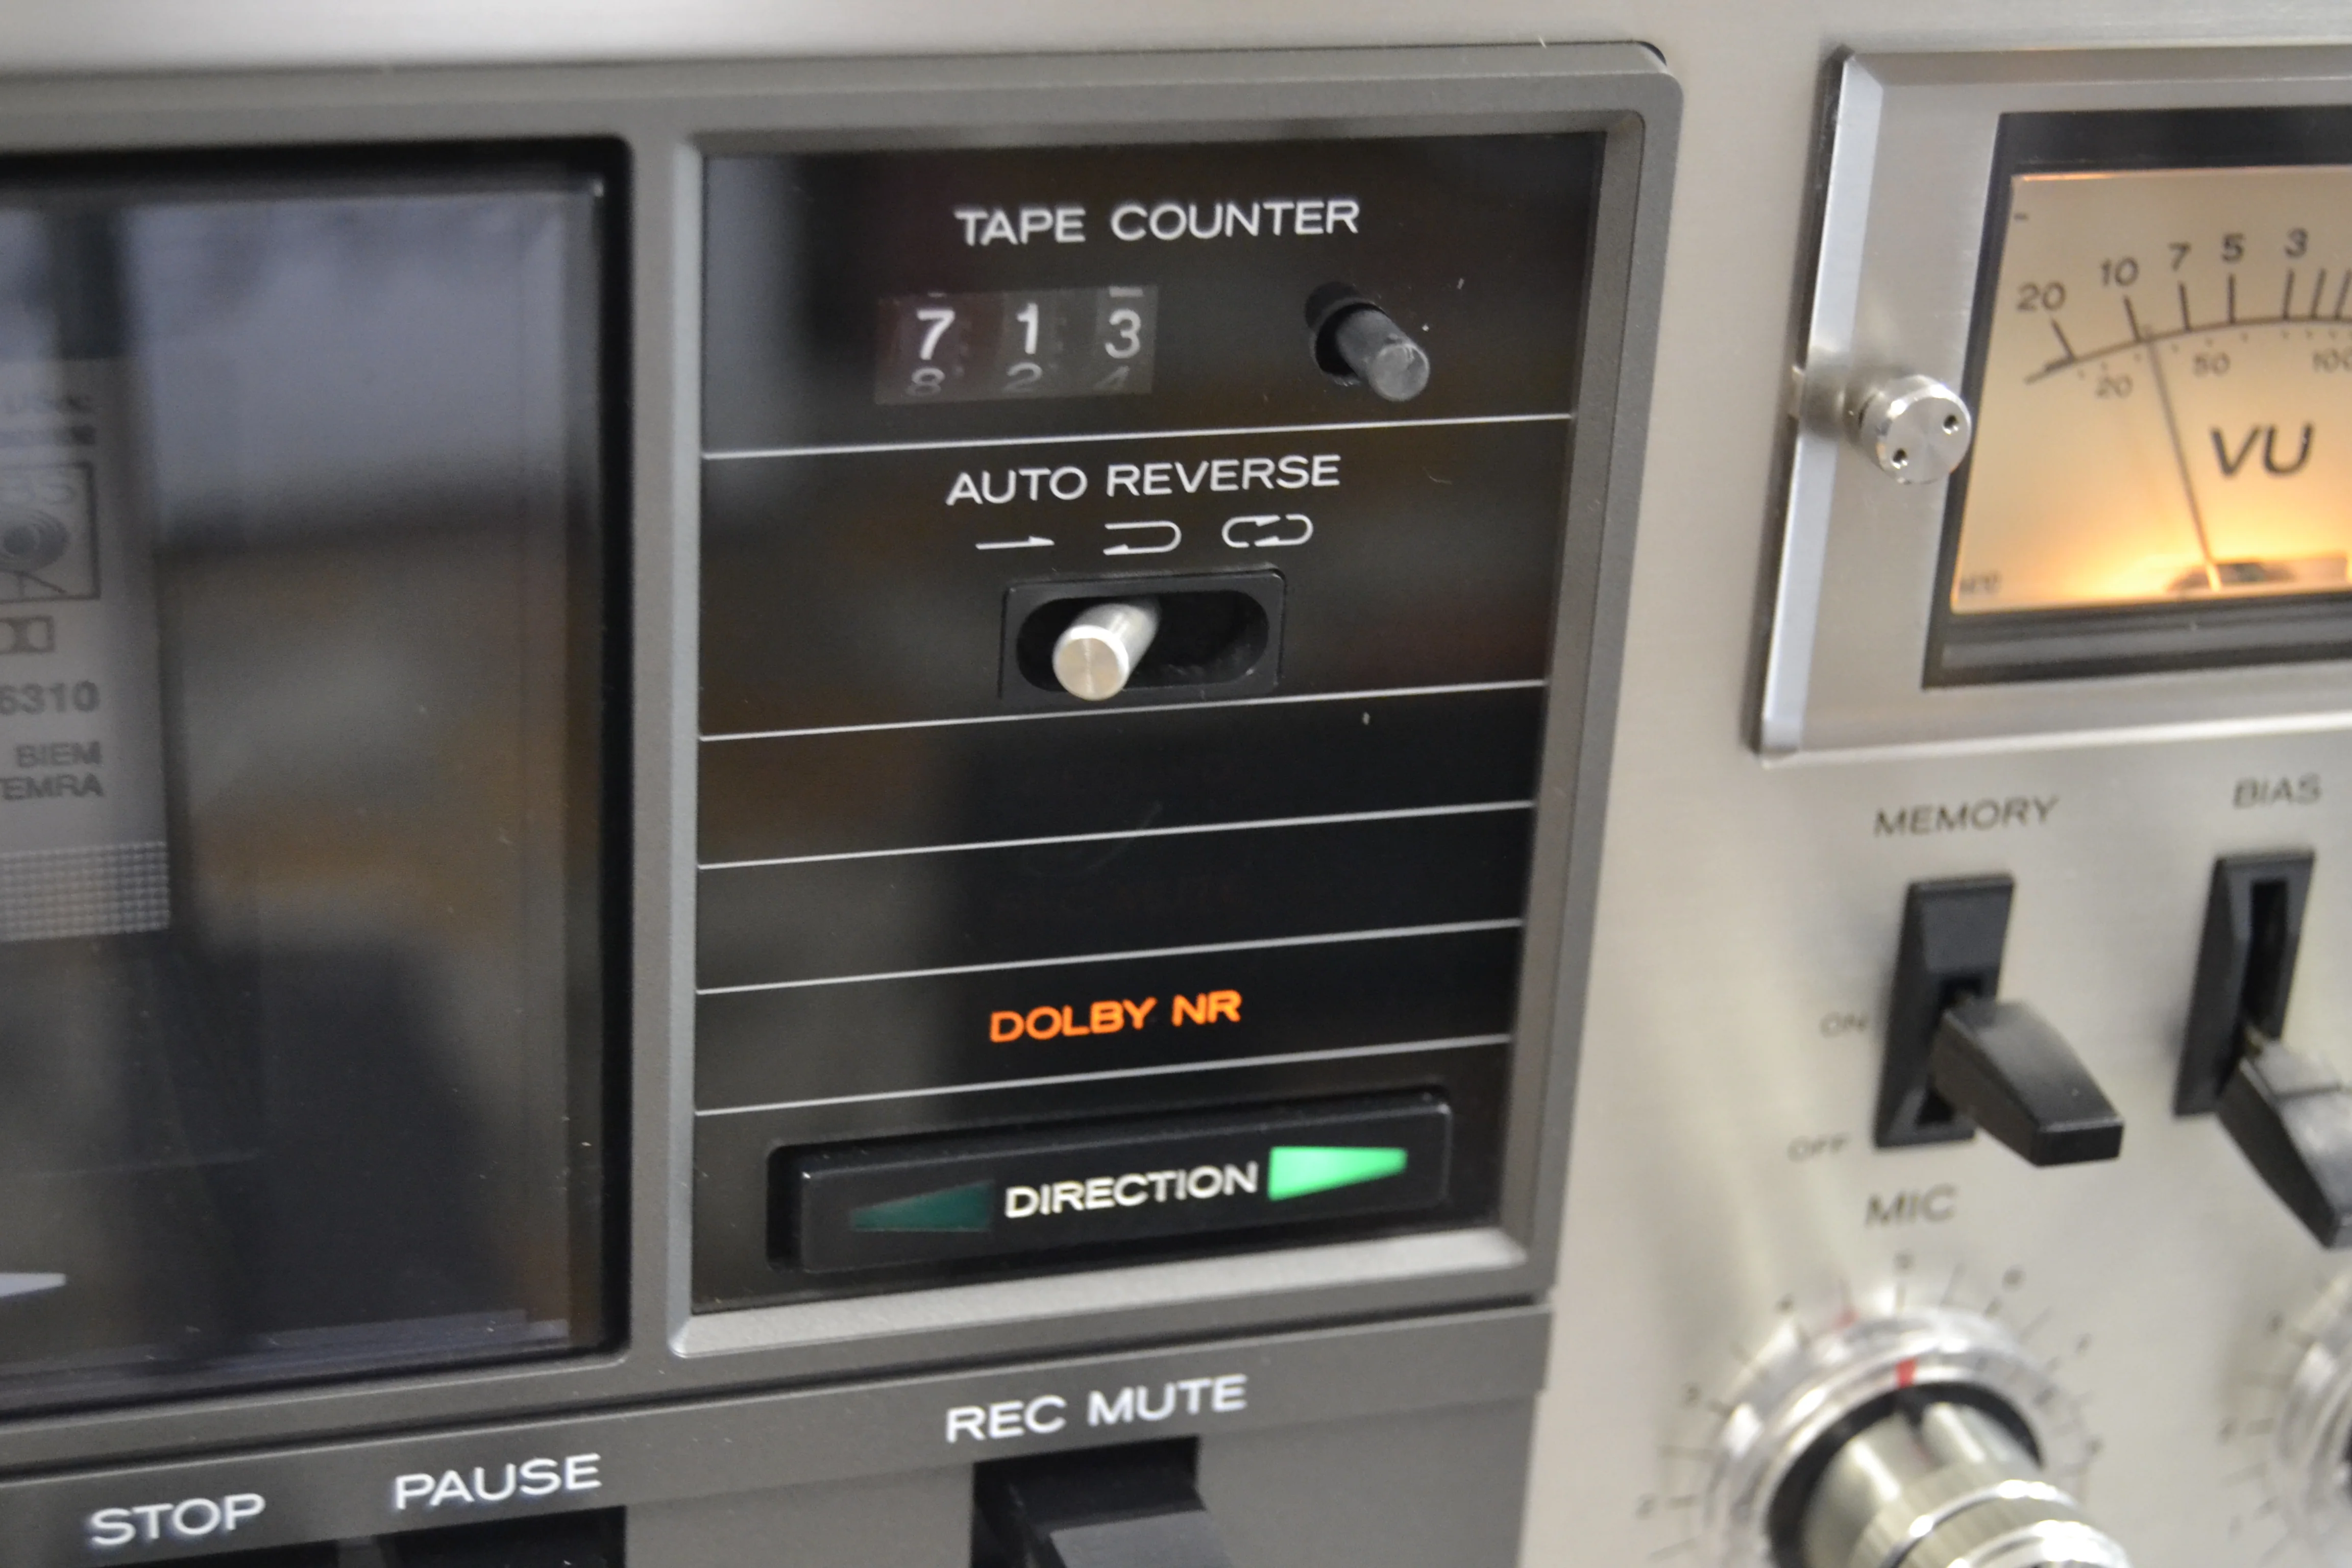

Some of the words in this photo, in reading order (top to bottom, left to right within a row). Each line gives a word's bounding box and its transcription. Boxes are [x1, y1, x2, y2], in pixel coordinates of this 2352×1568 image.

[954, 206, 1086, 246] TAPE
[1110, 199, 1360, 241] COUNTER
[2016, 280, 2067, 312] 20
[2099, 256, 2140, 287] 10
[2169, 241, 2192, 271] 7
[2221, 233, 2245, 263] 5
[2284, 228, 2309, 259] 3
[2210, 422, 2315, 477] VU
[945, 465, 1088, 506] AUTO
[1106, 454, 1341, 497] REVERSE
[16, 741, 103, 767] BIEM
[1873, 796, 2059, 837] MEMORY
[2233, 773, 2323, 808] BIAS
[989, 996, 1158, 1043] DOLBY
[1171, 989, 1243, 1027] NR
[1004, 1162, 1258, 1219] DIRECTION
[1866, 1186, 1956, 1225] MIC
[945, 1394, 1067, 1443] REC
[1088, 1373, 1247, 1426] MUTE
[394, 1452, 602, 1511] PAUSE
[89, 1491, 266, 1547] STOP
